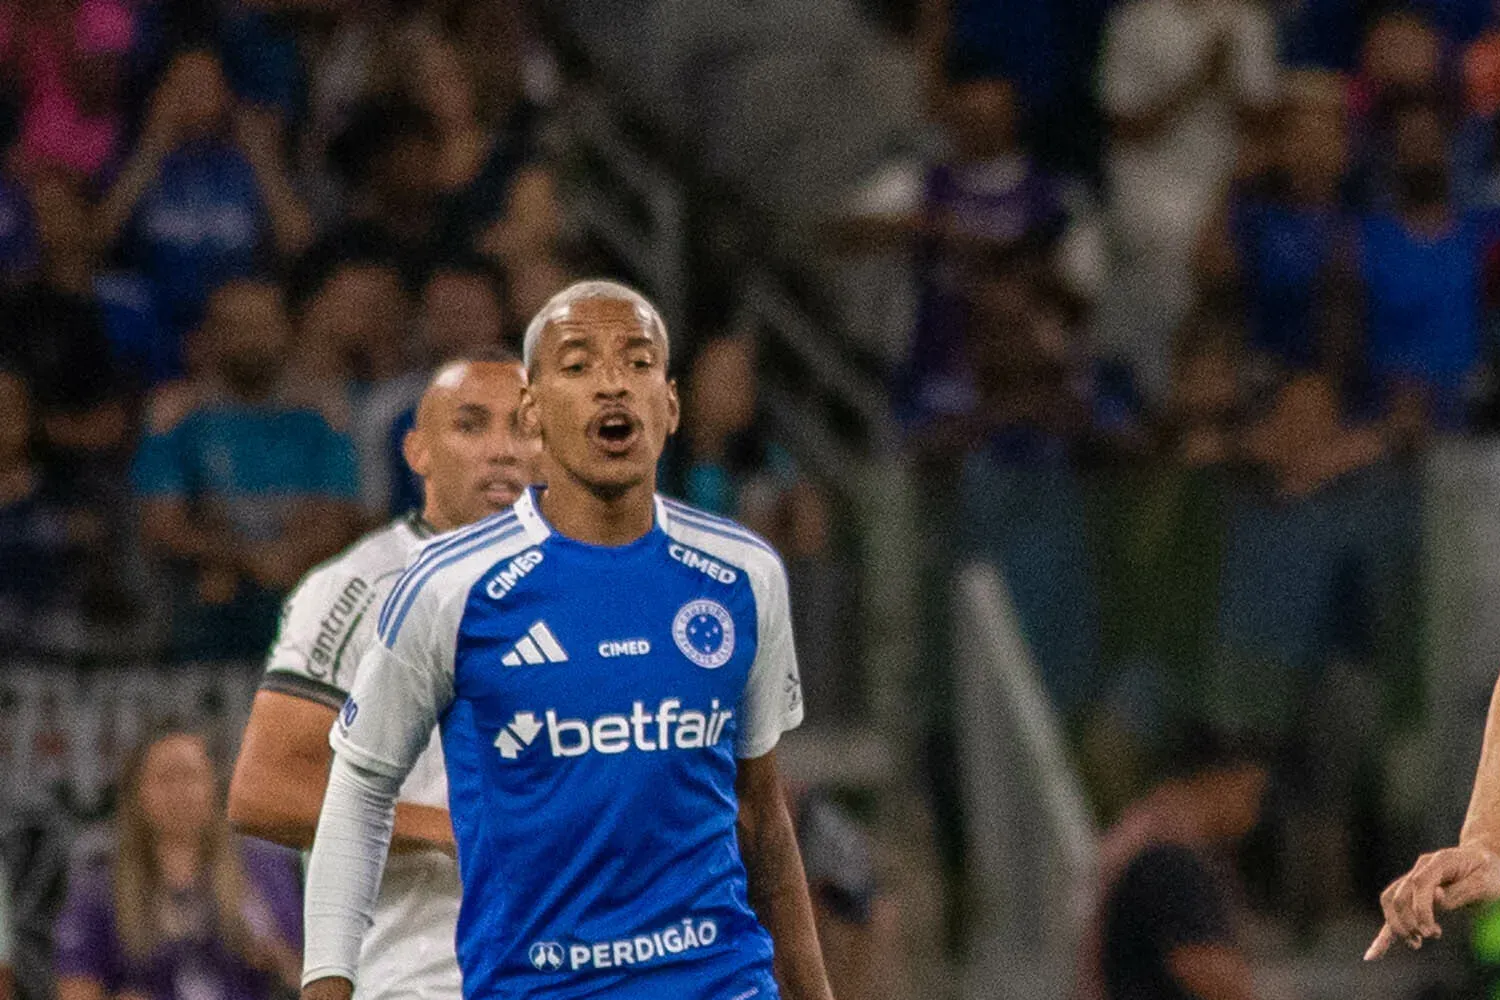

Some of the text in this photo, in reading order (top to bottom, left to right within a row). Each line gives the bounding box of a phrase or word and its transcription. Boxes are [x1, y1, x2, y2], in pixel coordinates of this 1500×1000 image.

[486, 550, 544, 600] CIMED
[668, 544, 737, 585] CIMED
[306, 576, 368, 680] Centrum
[598, 638, 650, 658] CIMED
[545, 697, 733, 757] betfair
[570, 918, 717, 970] PERDIGÃO
